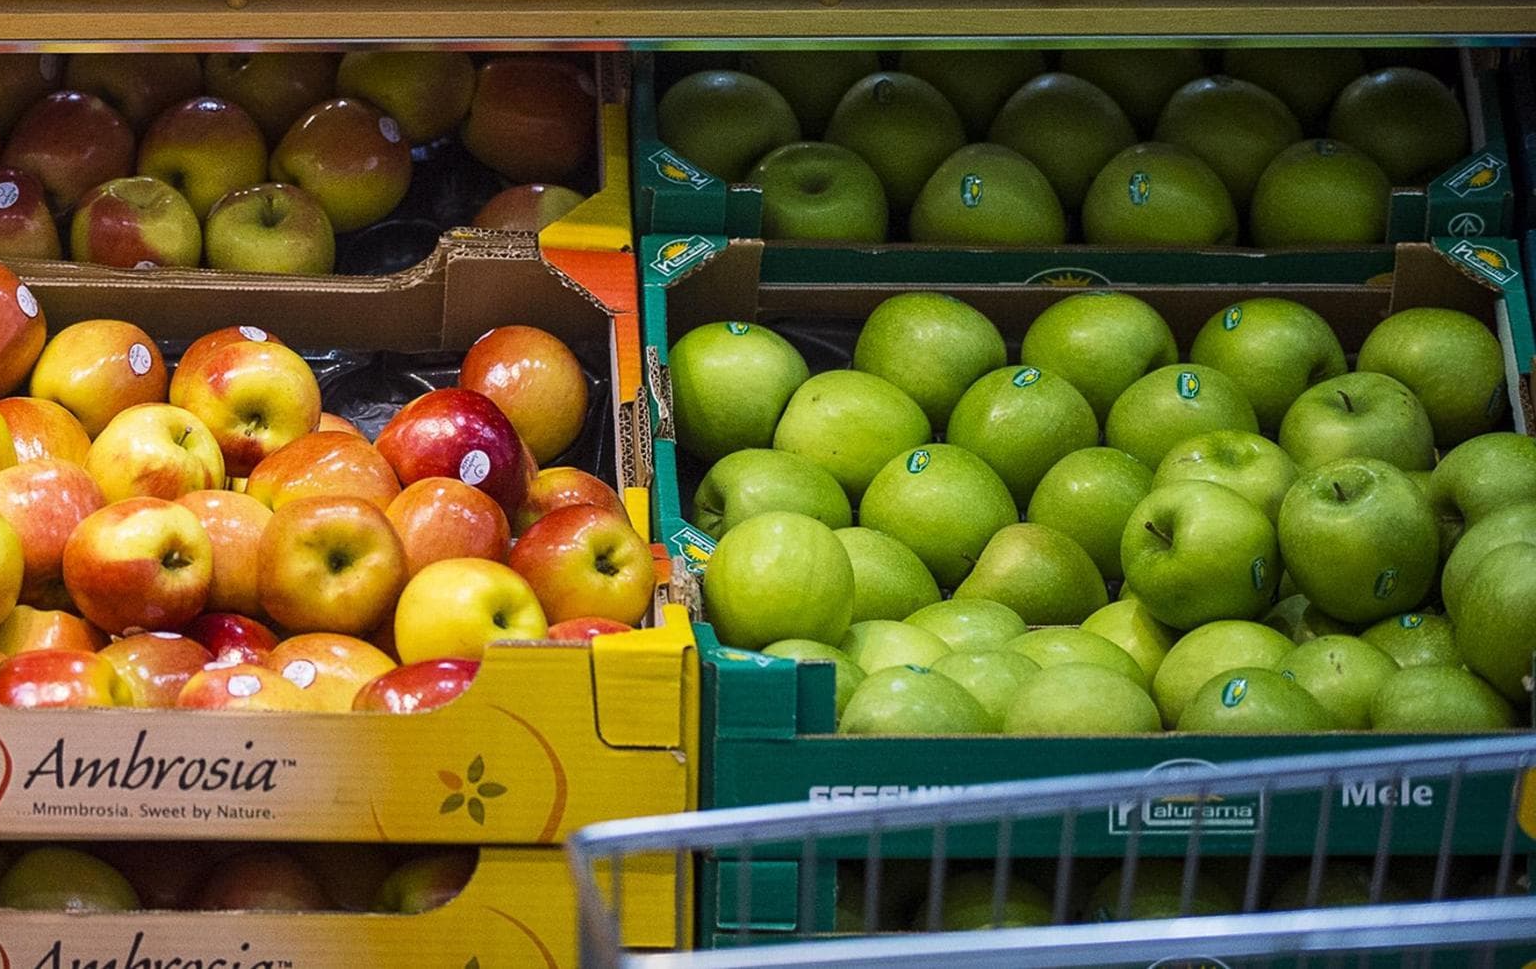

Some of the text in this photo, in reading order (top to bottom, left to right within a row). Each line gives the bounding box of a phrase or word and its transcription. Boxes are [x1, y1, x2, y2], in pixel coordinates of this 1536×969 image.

[1342, 777, 1434, 807] Mele
[139, 802, 186, 819] Sweet
[192, 803, 212, 821] by
[217, 804, 276, 820] Nature.
